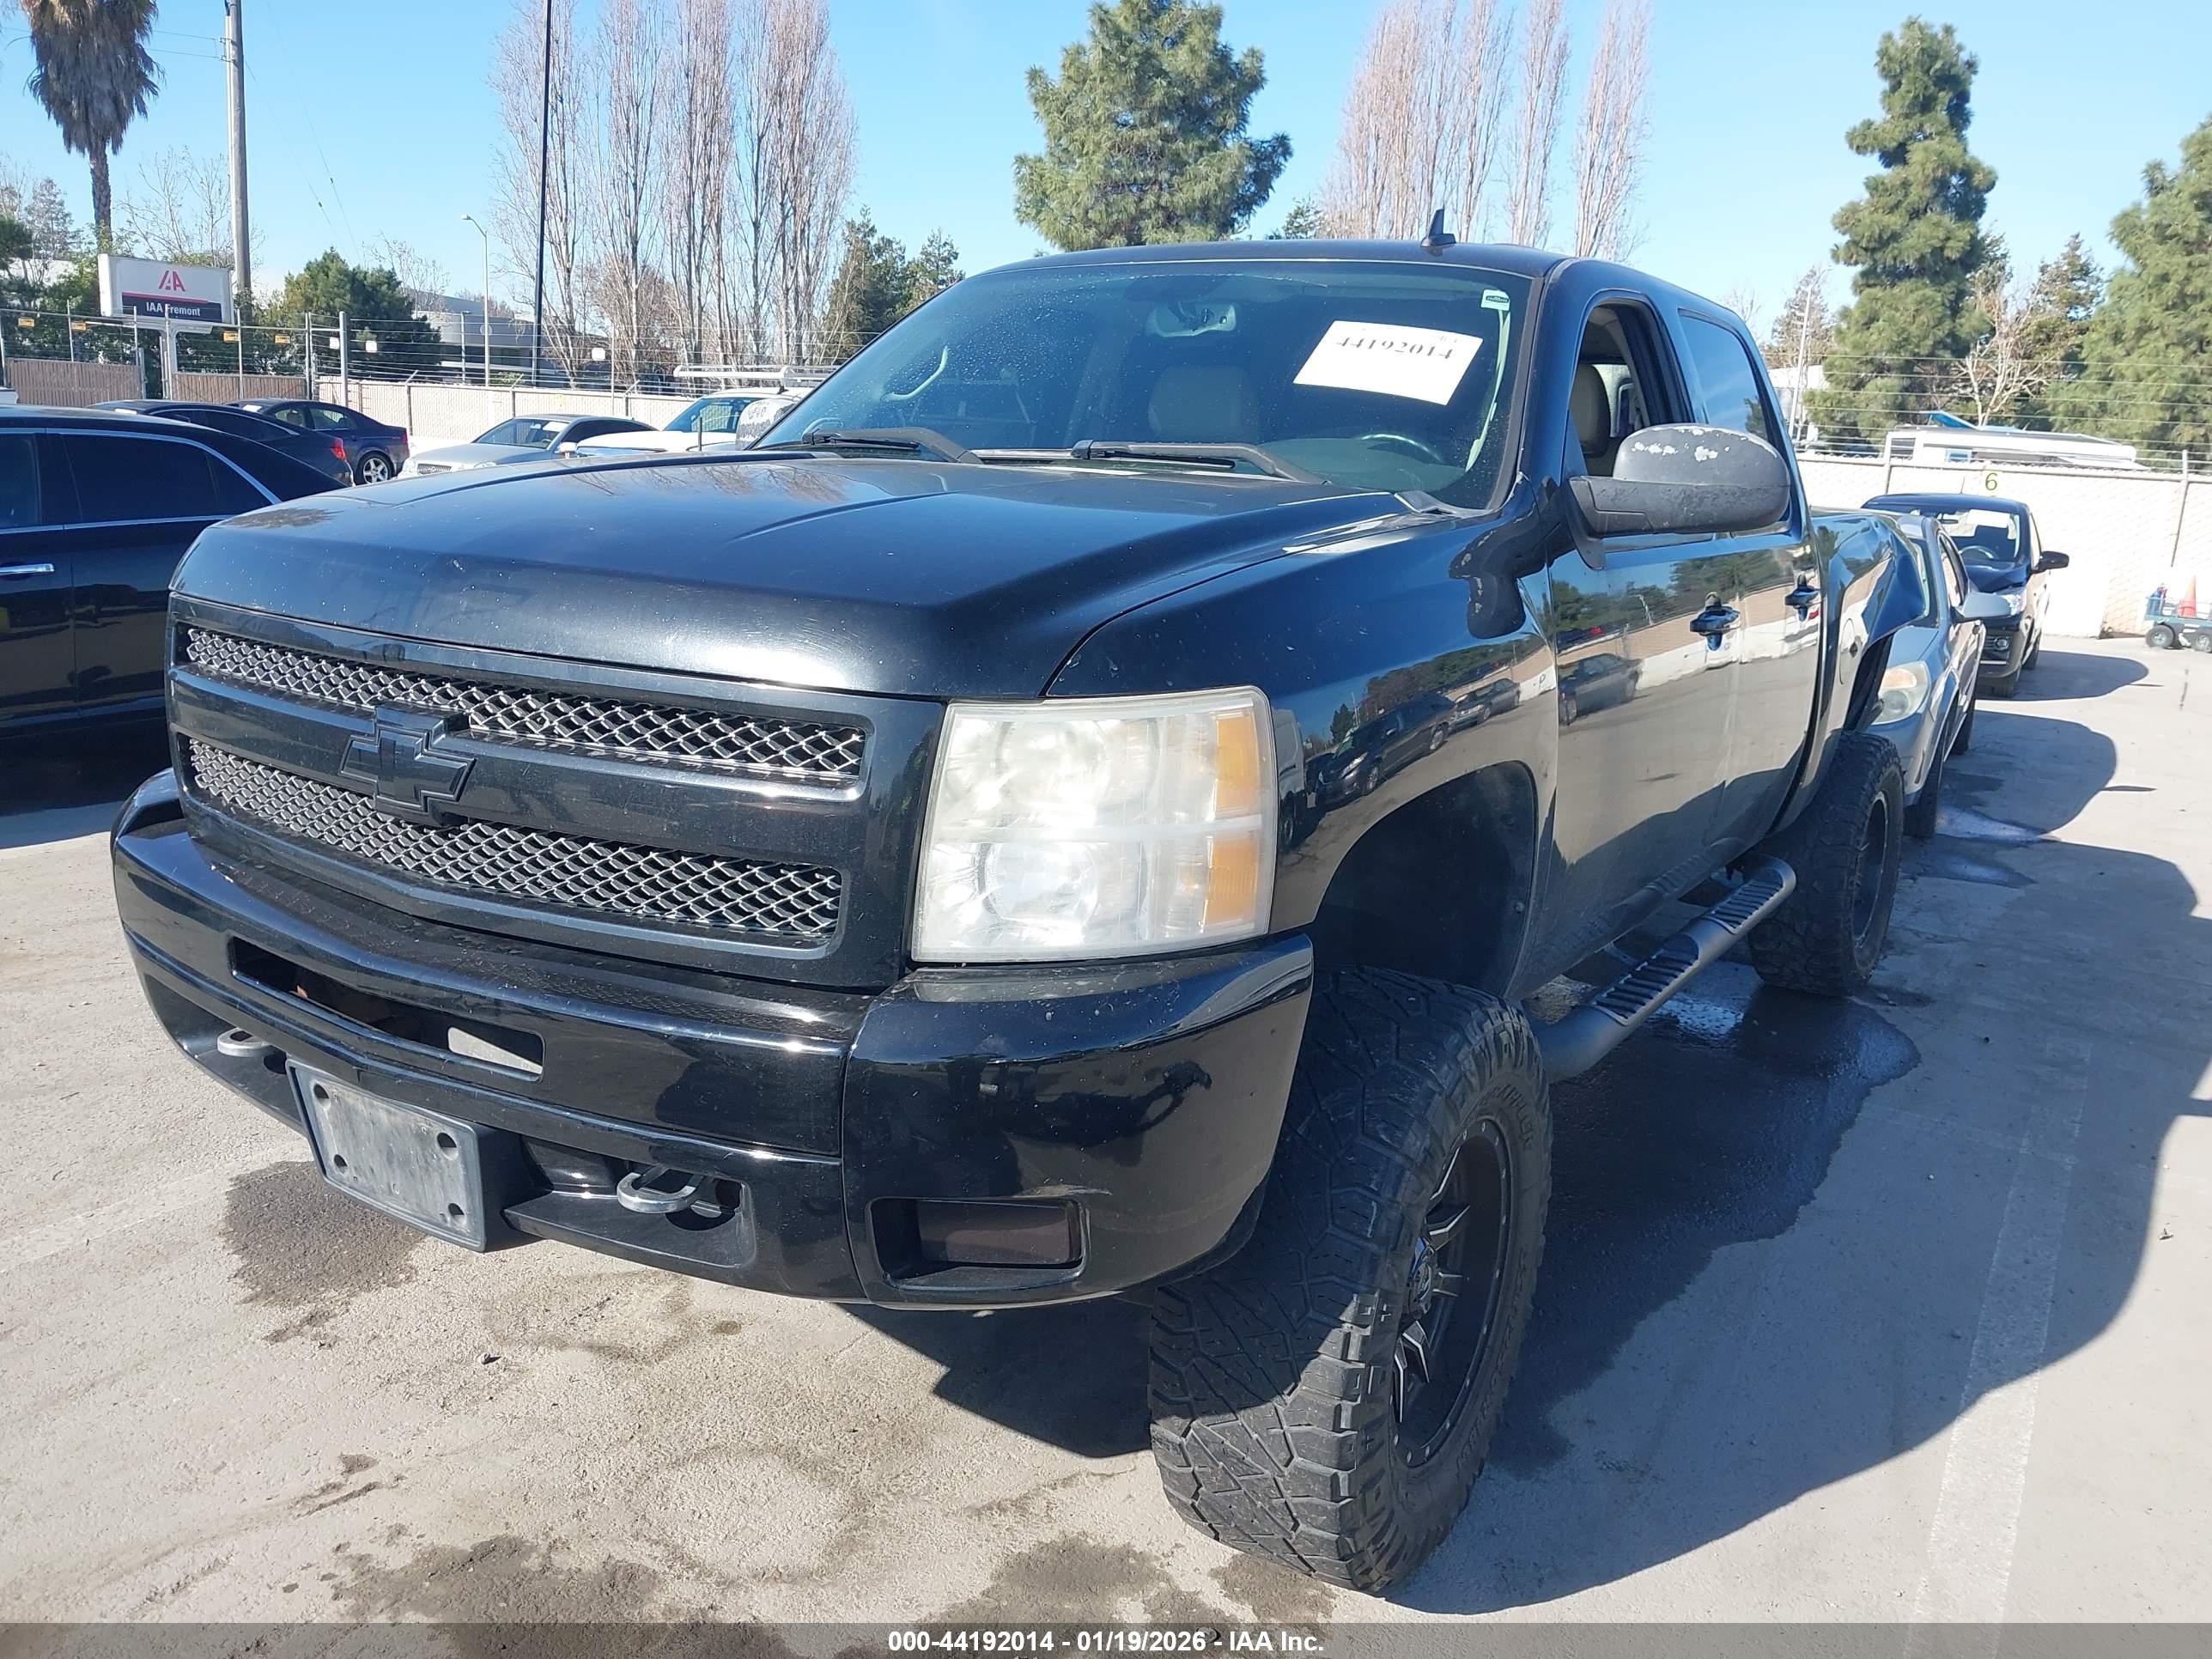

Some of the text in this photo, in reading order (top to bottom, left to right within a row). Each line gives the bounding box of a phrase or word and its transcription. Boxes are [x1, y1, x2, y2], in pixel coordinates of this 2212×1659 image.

[146, 301, 201, 317] IAA Fremont
[1336, 336, 1454, 360] 44192014
[1985, 472, 1998, 491] 6
